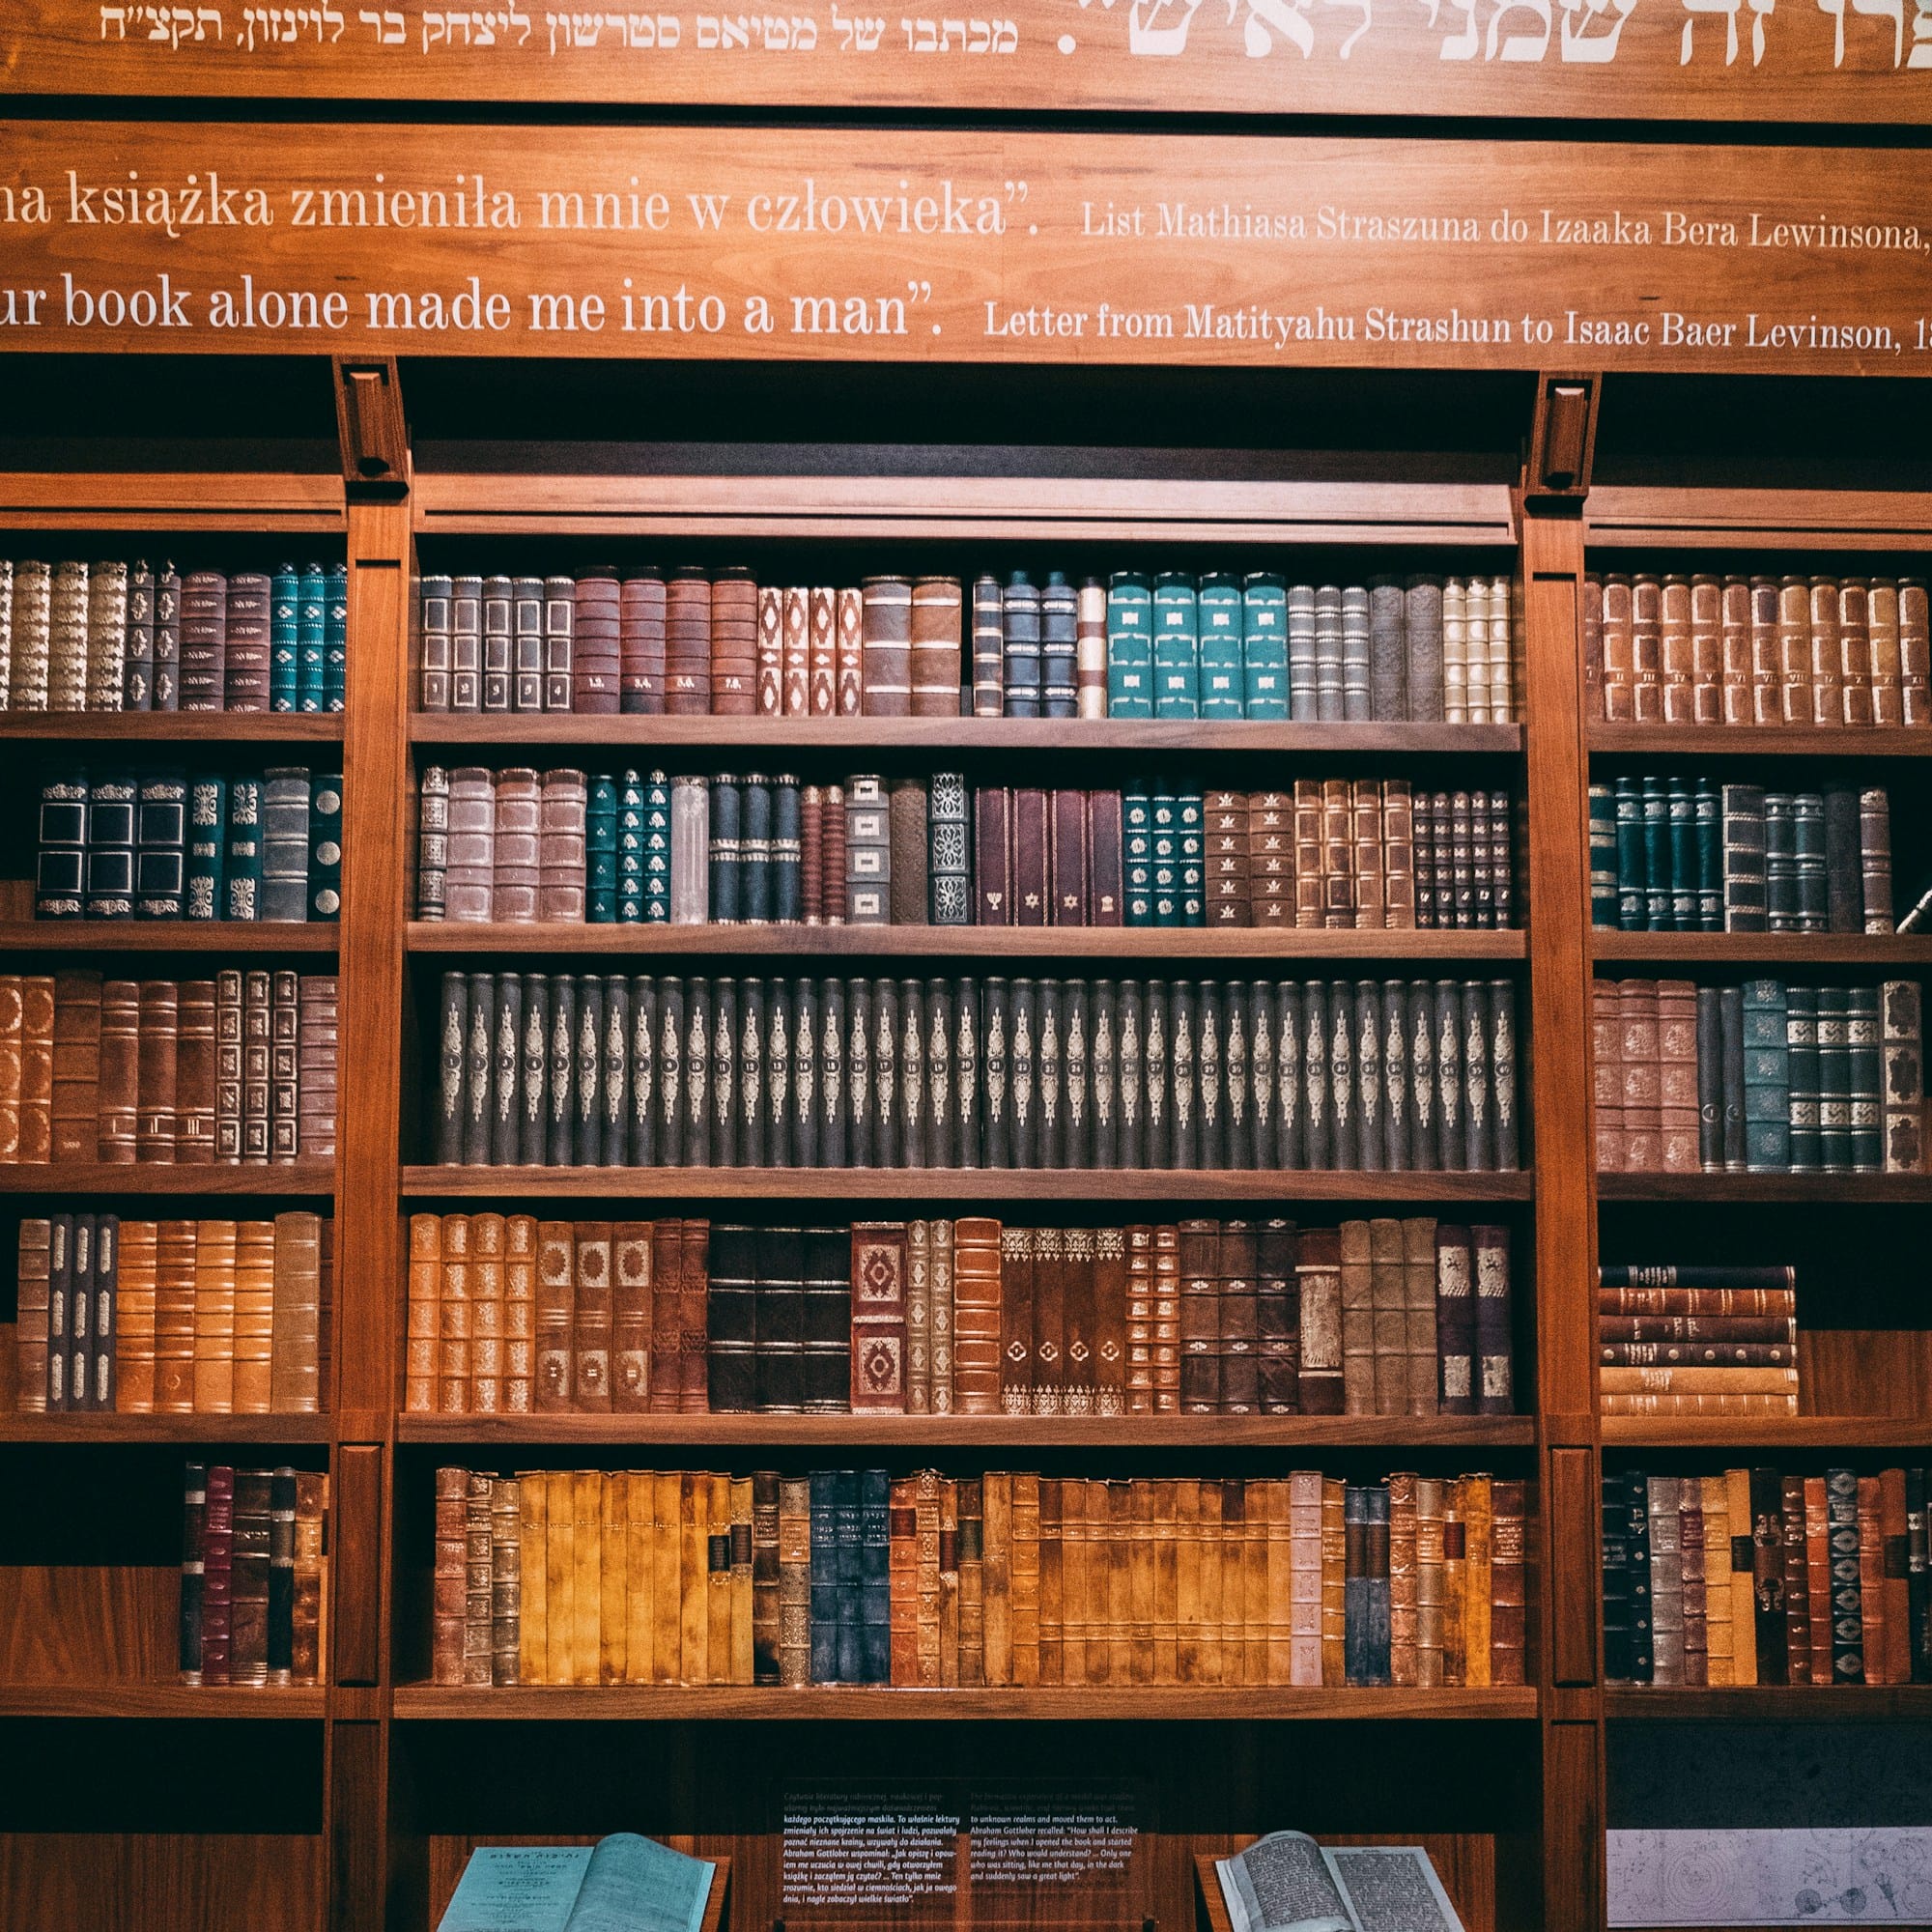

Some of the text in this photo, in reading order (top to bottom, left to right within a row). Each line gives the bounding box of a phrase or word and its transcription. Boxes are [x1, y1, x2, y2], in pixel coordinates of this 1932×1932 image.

[237, 0, 345, 52] לוינזון,
[358, 10, 408, 44] בר
[422, 0, 531, 55] ליצחק
[696, 14, 818, 50] מטיאס
[831, 4, 886, 51] של
[546, 11, 681, 57] סטרשון
[901, 17, 1018, 54] מכתבו
[66, 169, 274, 238] książka
[292, 173, 522, 229] zmieniła
[536, 177, 670, 230] mnie
[687, 193, 730, 231] w
[1081, 203, 1931, 256] List Mathiasa Straszuna do Izaaka Bera Lewinsona,
[60, 272, 193, 327] book
[210, 274, 349, 329] alone
[365, 276, 511, 330] made
[527, 294, 606, 331] me
[620, 278, 726, 332] into
[744, 296, 775, 333] a
[983, 301, 1932, 356] Letter from Matityahu Strashun to Isaac Baer Levinson, 1
[783, 1814, 811, 1826] każdego
[897, 1814, 906, 1824] To
[908, 1814, 934, 1824] właśnie
[935, 1814, 960, 1826] lektury
[971, 1814, 1118, 1824] to unknown realms and moved them to act.
[819, 1825, 829, 1835] ich
[877, 1825, 895, 1835] świat
[901, 1825, 920, 1837] ludzi,
[970, 1825, 1002, 1835] Abraham
[1088, 1825, 1105, 1835] shall
[783, 1836, 808, 1848] poznać
[1010, 1836, 1029, 1847] when
[1036, 1836, 1060, 1848] opened
[1062, 1836, 1073, 1847] the
[1074, 1836, 1092, 1847] book
[1093, 1836, 1106, 1847] and
[1108, 1836, 1132, 1847] started
[782, 1848, 814, 1858] Abraham
[970, 1847, 1132, 1860] reading Who would understand? Only one
[810, 1859, 836, 1869] uczucia
[864, 1859, 886, 1871] chwili,
[970, 1859, 985, 1869] who
[987, 1861, 1001, 1869] was
[1028, 1859, 1040, 1869] like
[1054, 1859, 1068, 1869] that
[1070, 1859, 1086, 1871] day,
[1095, 1859, 1107, 1869] the
[1108, 1859, 1124, 1869] dark
[783, 1870, 809, 1883] książkę
[891, 1870, 903, 1881] Ten
[905, 1870, 923, 1883] tylko
[924, 1870, 941, 1881] mnie
[970, 1870, 983, 1880] and
[1038, 1870, 1058, 1882] great
[935, 1884, 957, 1893] owego
[783, 1893, 800, 1905] dnia,
[807, 1893, 826, 1905] nagle
[859, 1893, 882, 1903] wielkie
